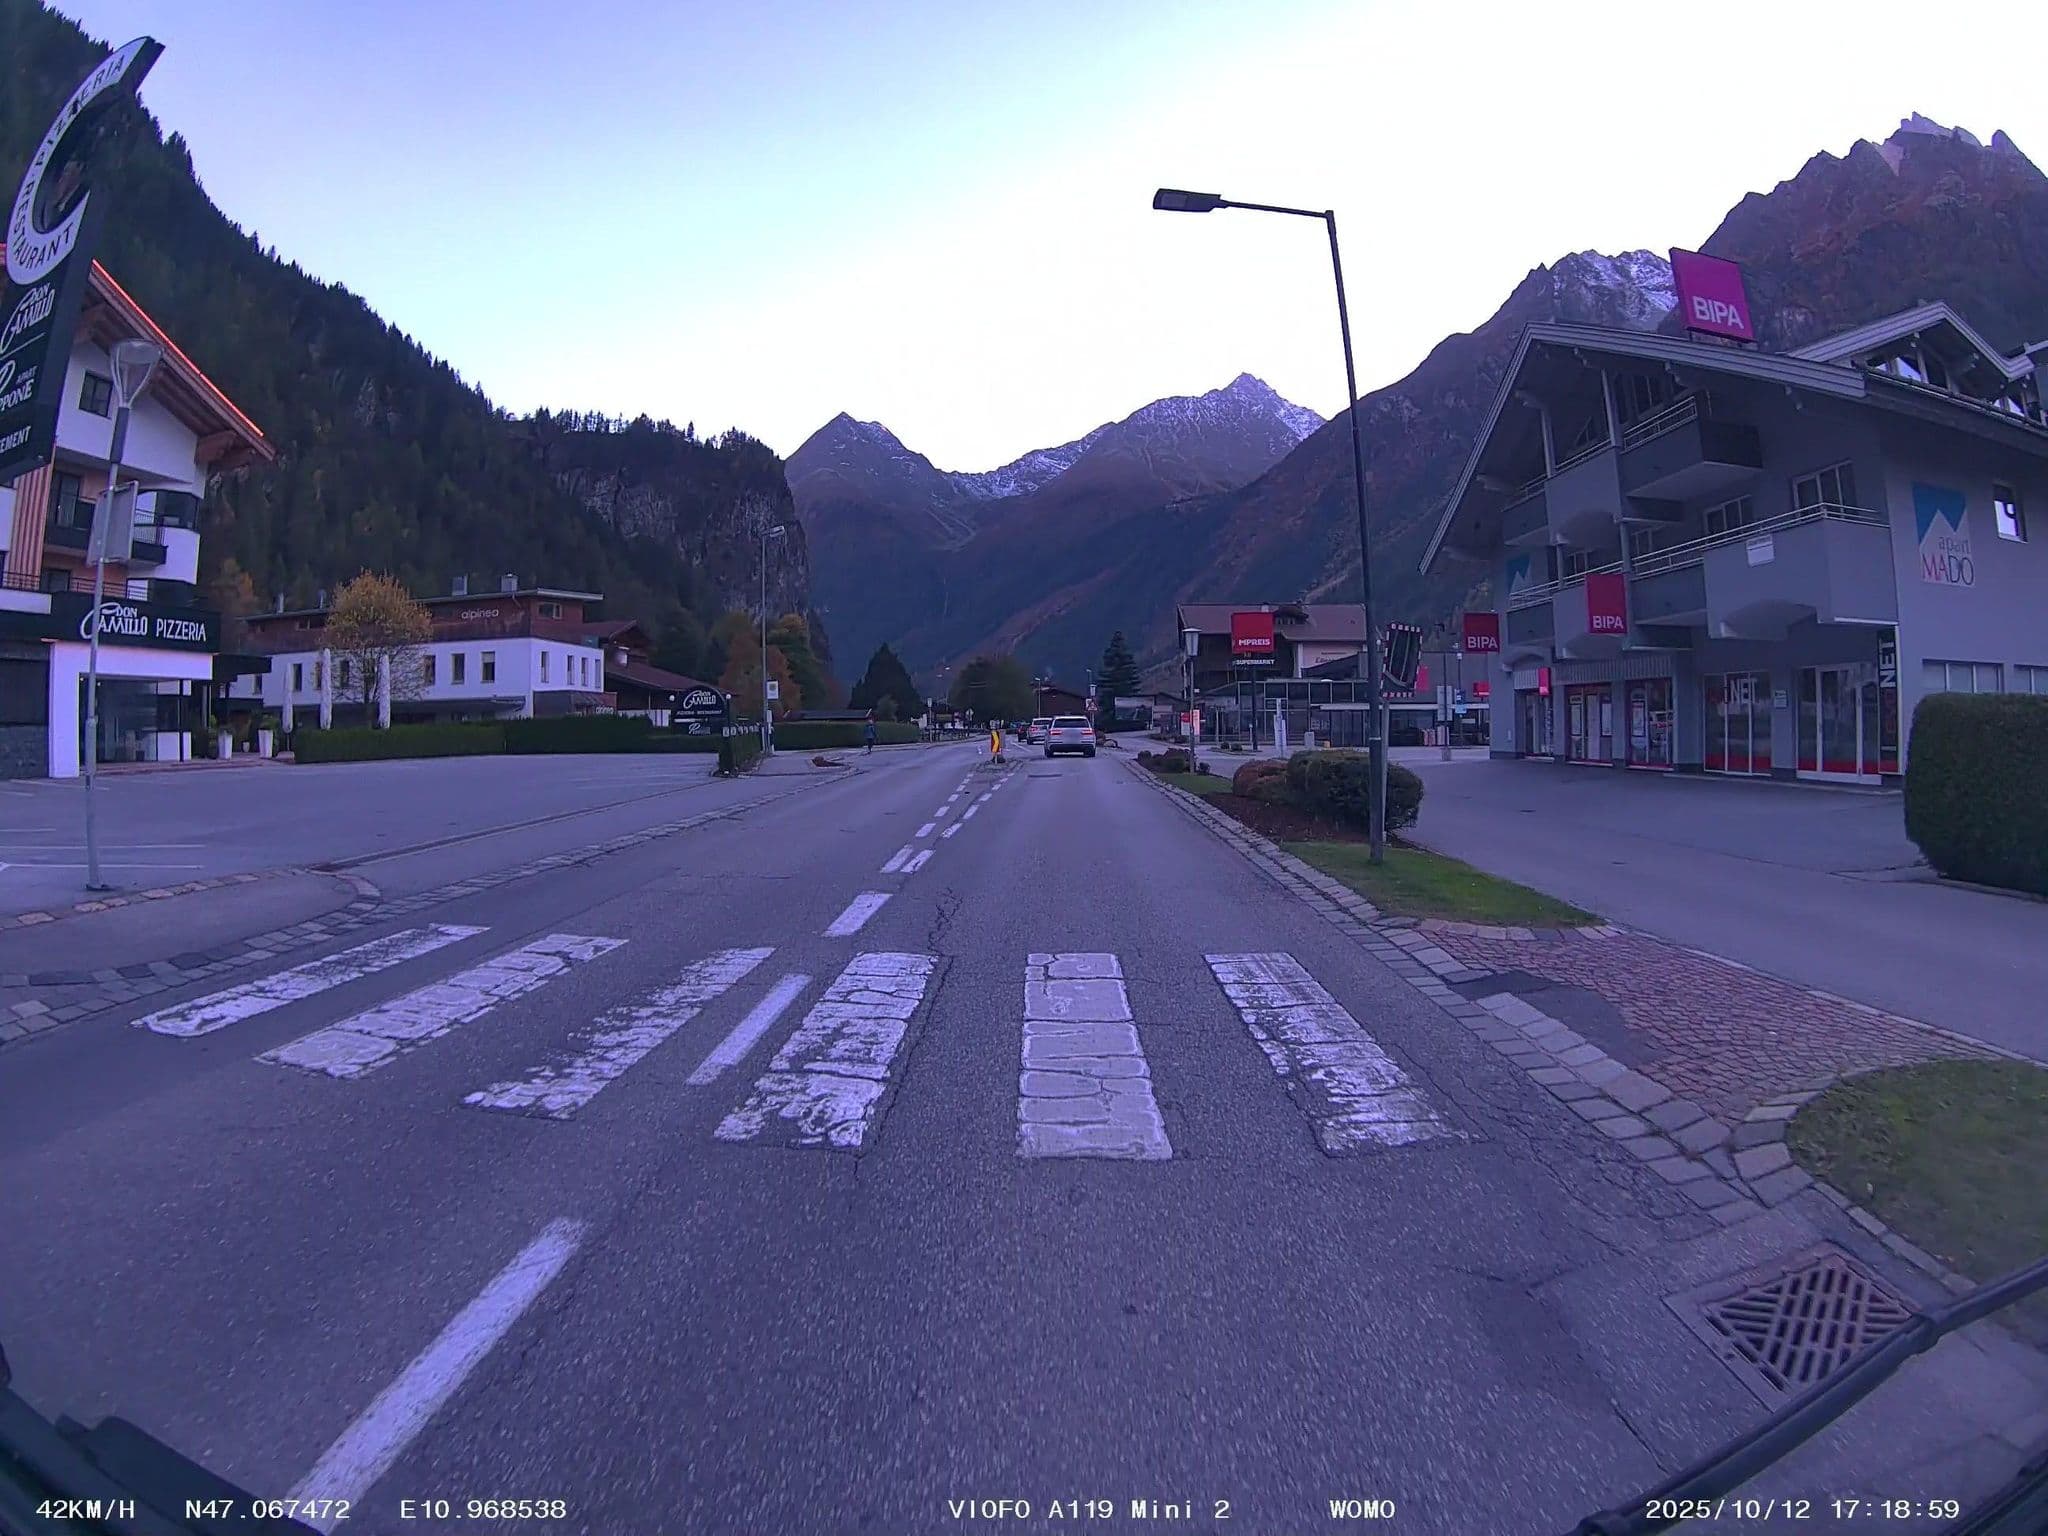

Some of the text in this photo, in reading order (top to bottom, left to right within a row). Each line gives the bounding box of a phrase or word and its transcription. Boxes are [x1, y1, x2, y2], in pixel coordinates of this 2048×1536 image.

[13, 181, 74, 270] RESTAURANT
[1692, 295, 1744, 330] BIPA
[1922, 553, 1974, 586] MADO
[80, 602, 207, 642] CAMILLO PIZZERIA
[115, 606, 138, 618] DON
[1592, 615, 1624, 629] BIPA
[1238, 638, 1271, 646] MPREIS
[1467, 636, 1498, 649] BIPA
[1879, 641, 1897, 688] NET
